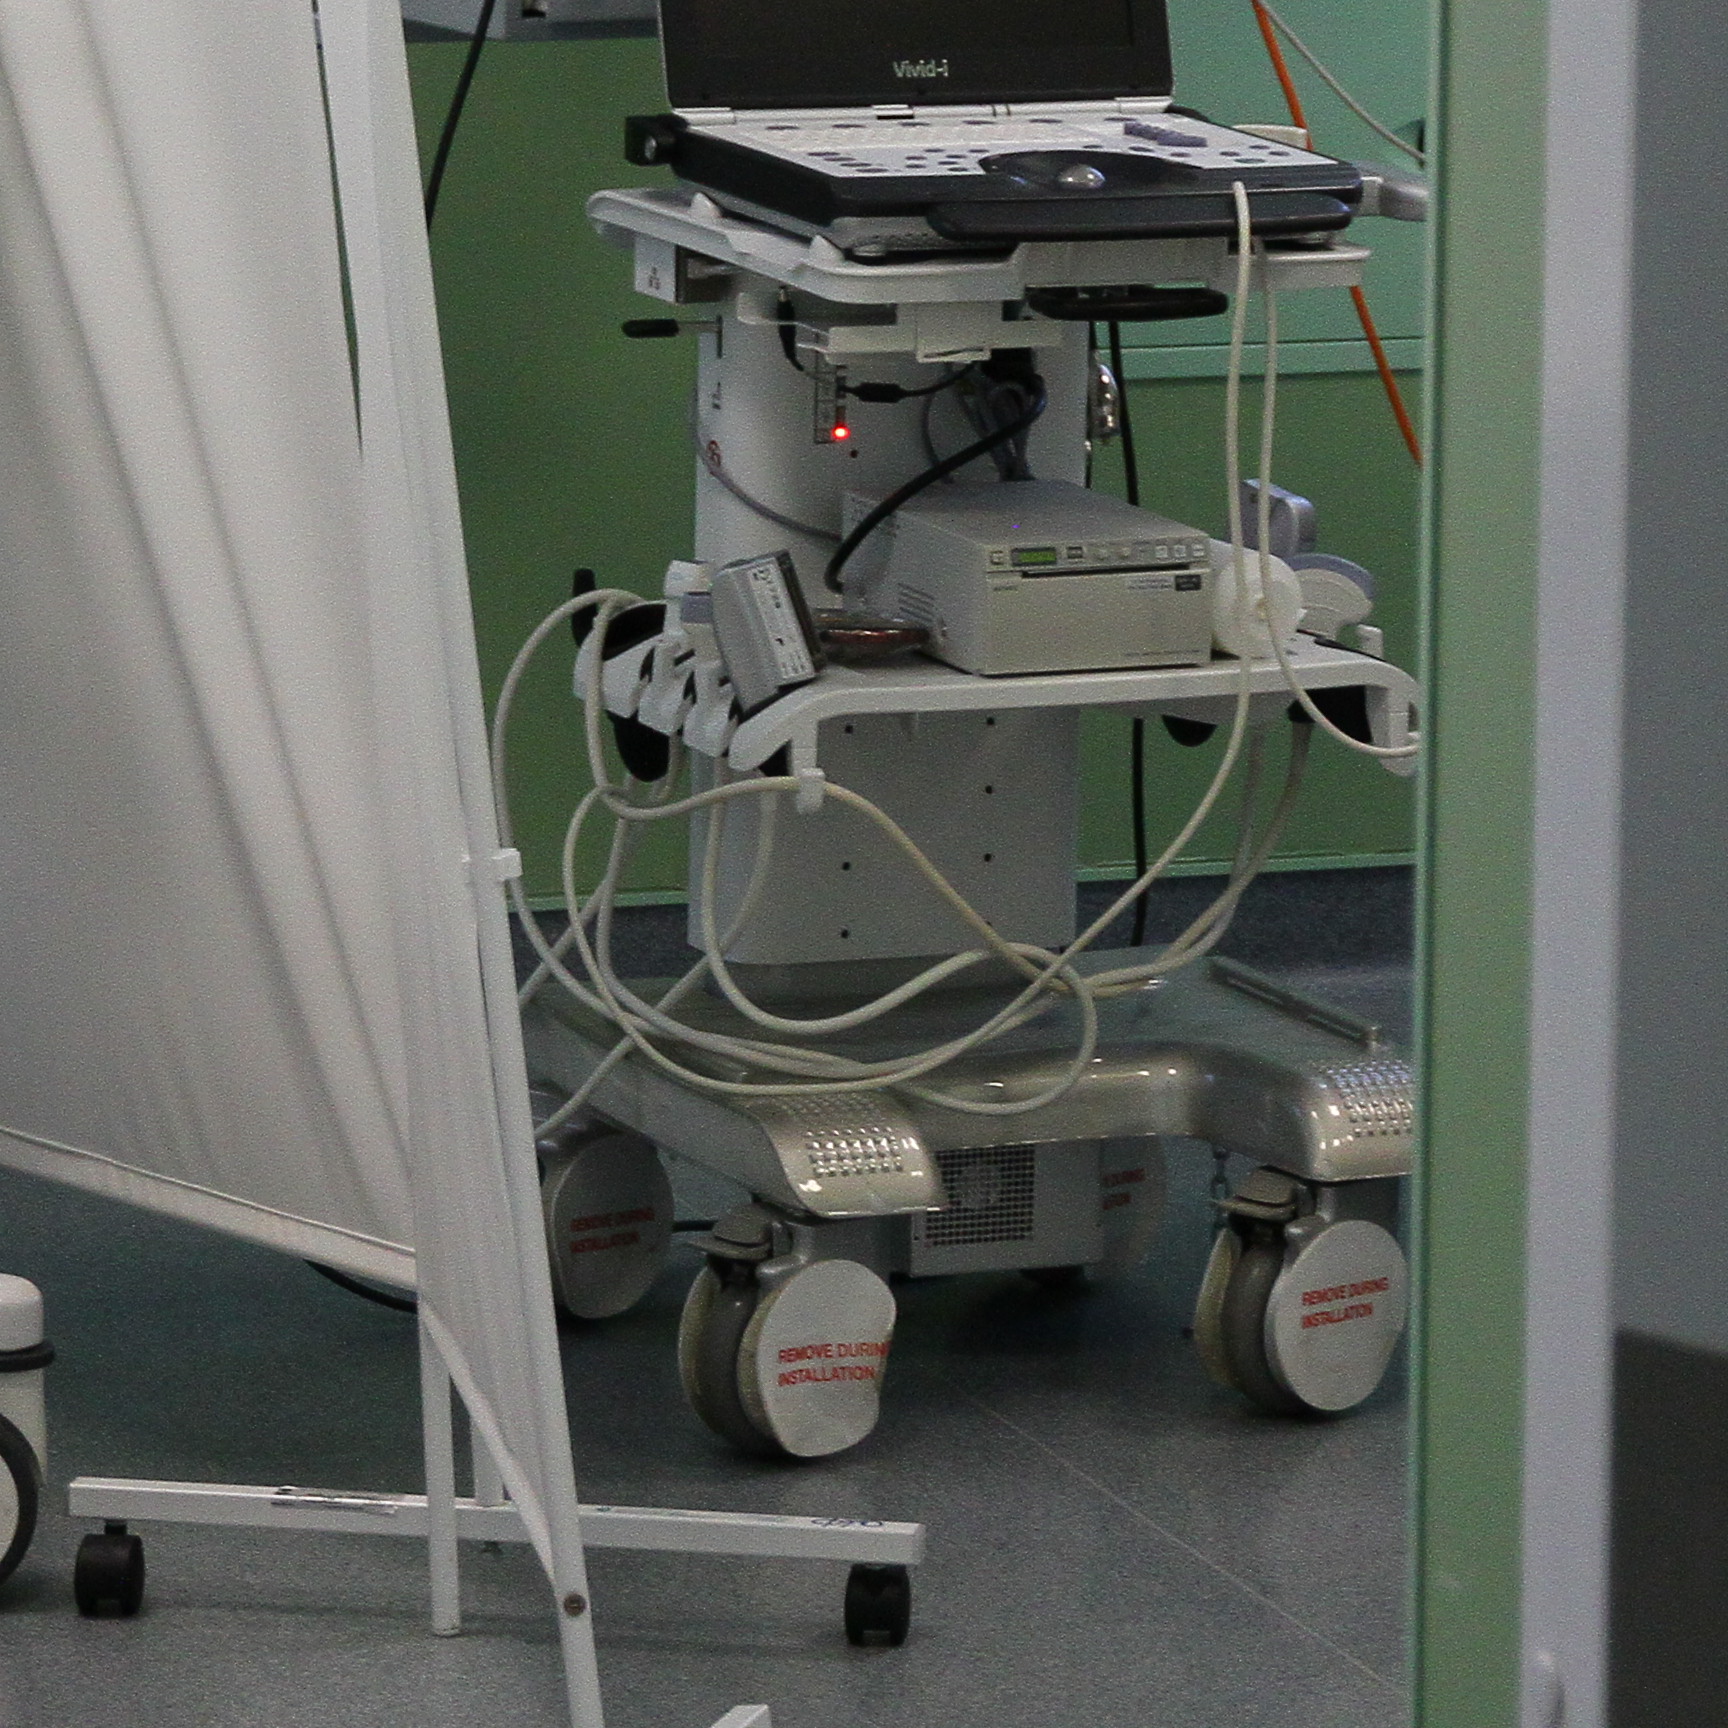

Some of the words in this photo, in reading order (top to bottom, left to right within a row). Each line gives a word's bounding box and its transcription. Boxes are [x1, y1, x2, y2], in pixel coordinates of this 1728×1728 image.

[893, 58, 949, 78] Vivid-i
[778, 1343, 832, 1364] REMOVE
[777, 1365, 875, 1387] INSTALLATION
